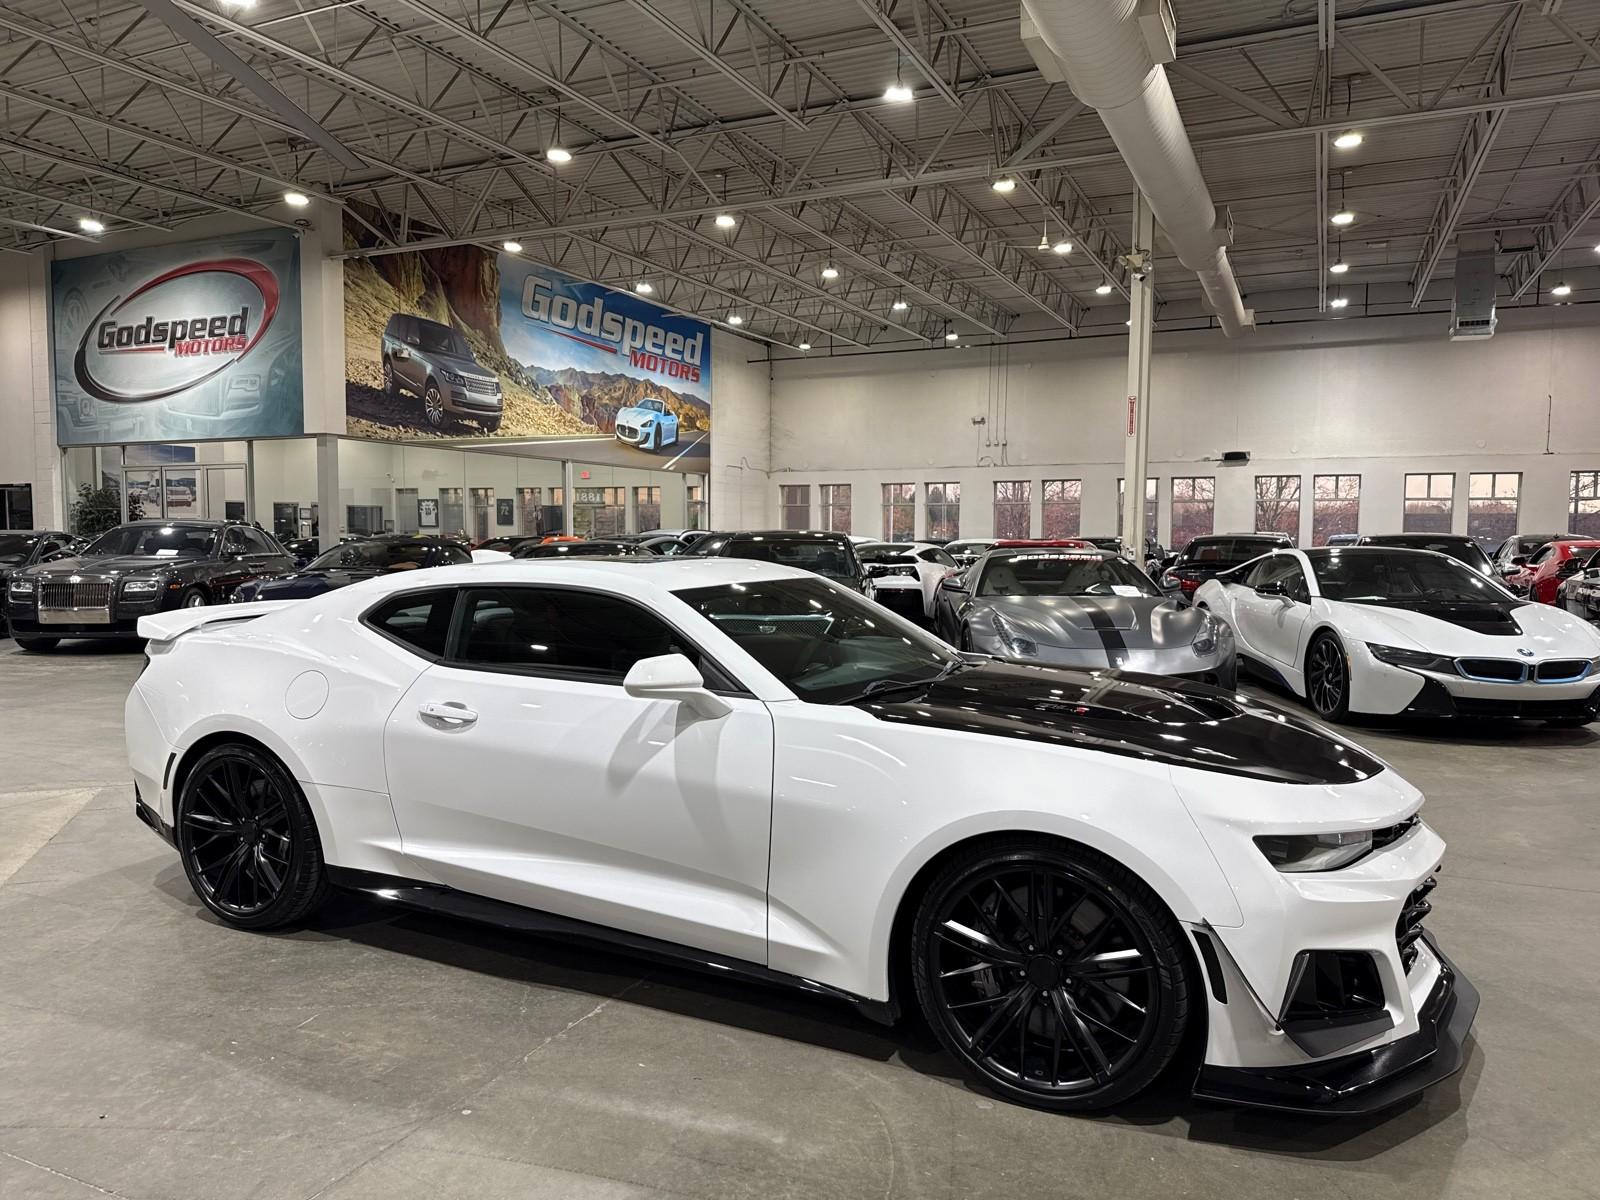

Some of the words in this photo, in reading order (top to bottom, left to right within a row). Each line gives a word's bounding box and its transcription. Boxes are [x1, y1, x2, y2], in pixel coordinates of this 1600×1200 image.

[97, 305, 249, 350] Godspeed
[521, 274, 704, 367] Godspeed
[174, 336, 247, 356] MOTORS
[629, 350, 700, 383] MOTORS
